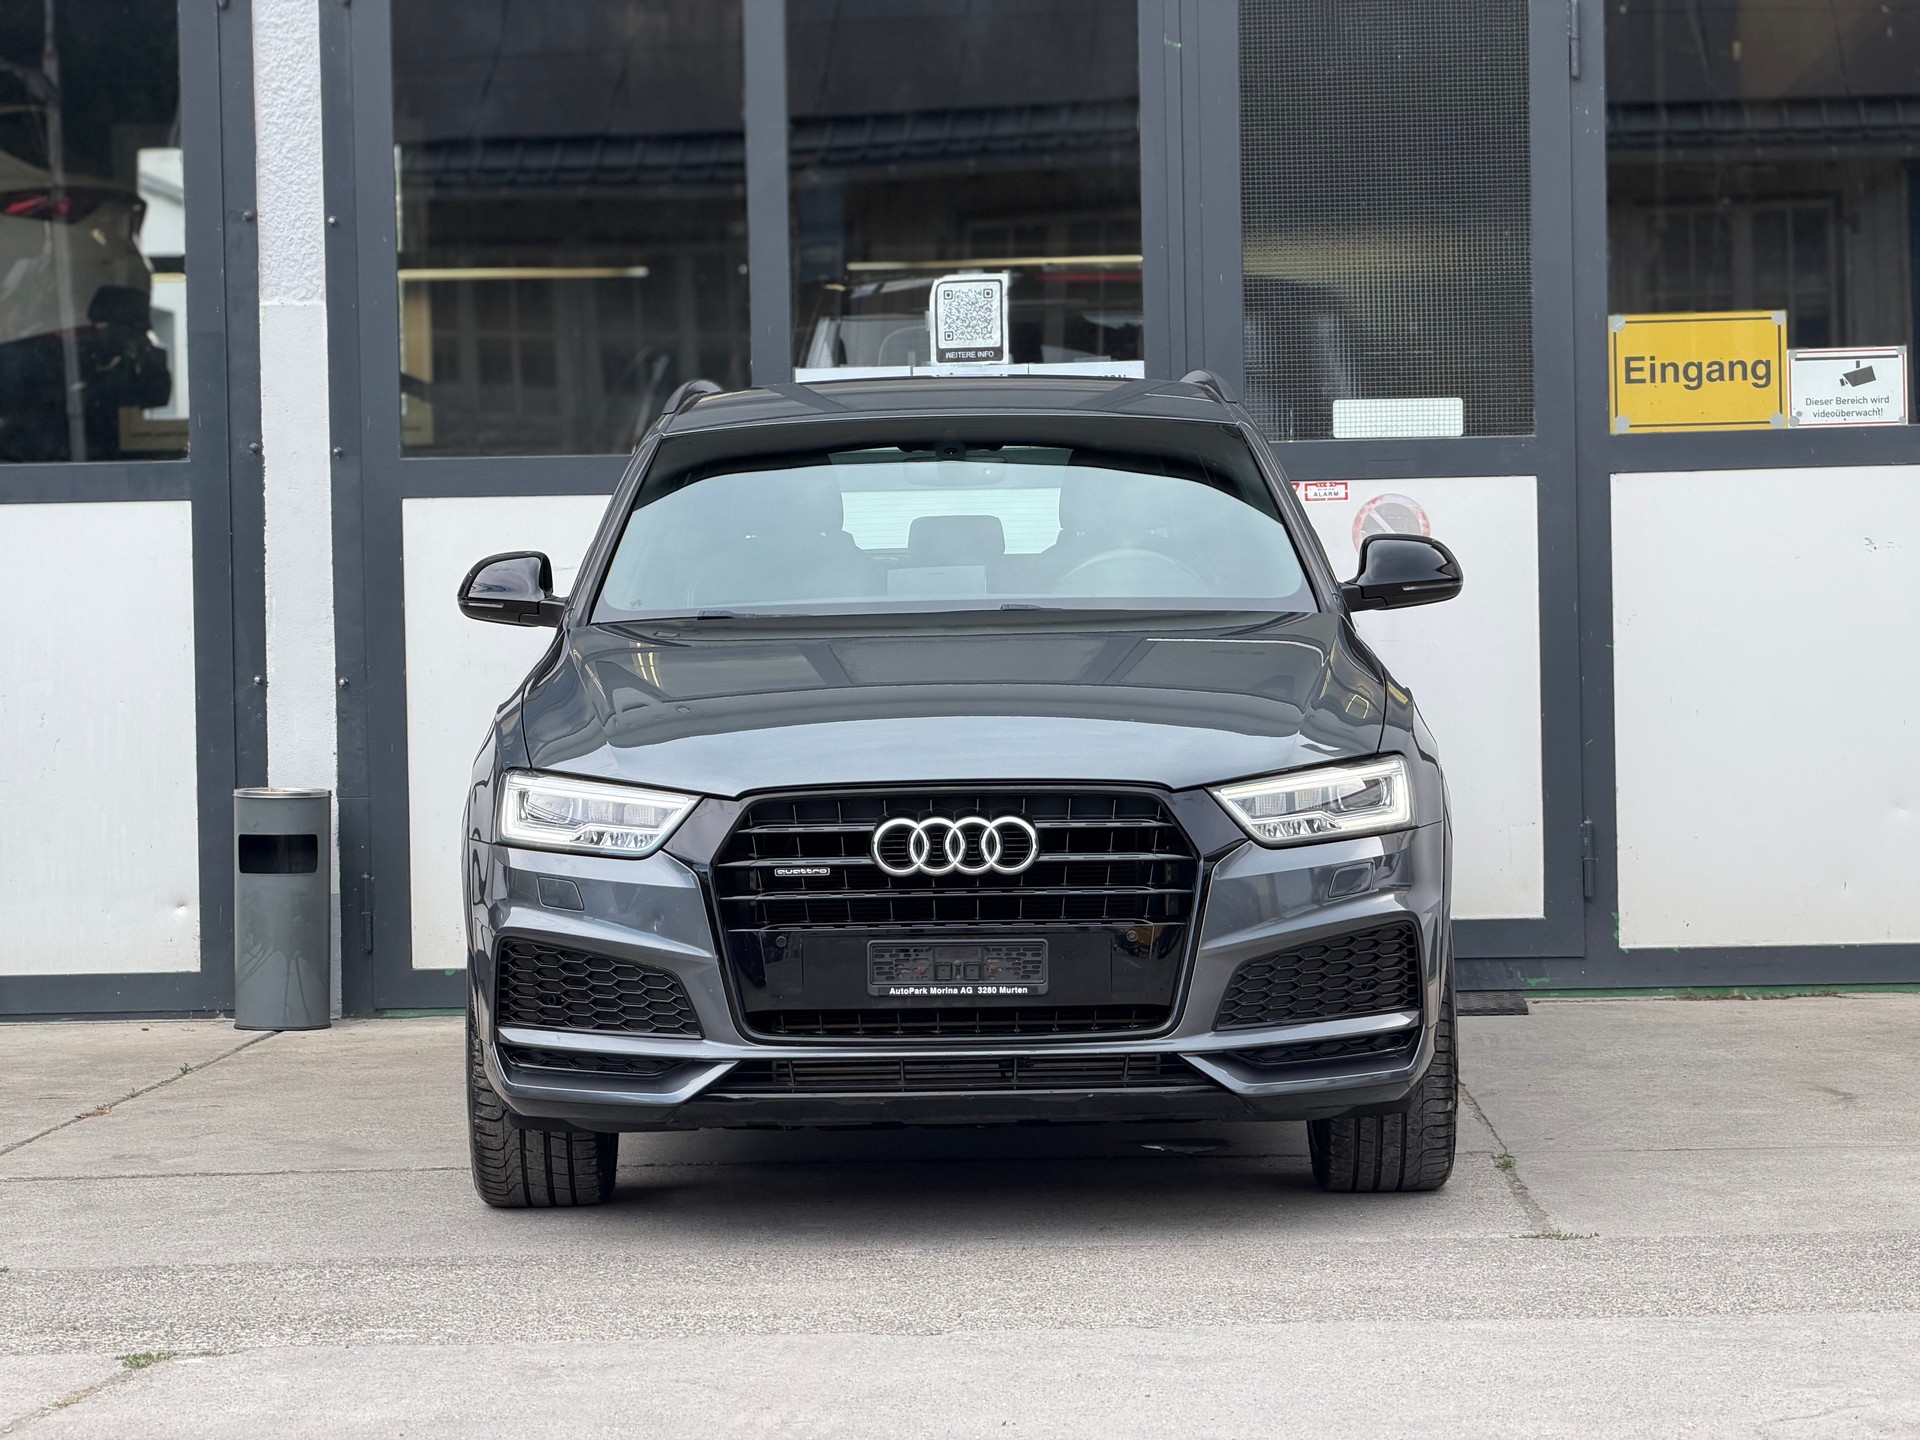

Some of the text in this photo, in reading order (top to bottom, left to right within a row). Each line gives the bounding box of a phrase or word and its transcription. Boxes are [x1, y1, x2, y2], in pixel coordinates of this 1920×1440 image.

[945, 350, 995, 359] WEITERE INFO
[1624, 355, 1772, 391] Eingang
[1805, 395, 1890, 406] Dieser Bereich wird
[1812, 407, 1884, 418] videoüberwacht!
[776, 868, 828, 876] quattro
[889, 987, 928, 995] AutoPark
[930, 987, 959, 995] Morina
[998, 986, 1028, 994] Murten
